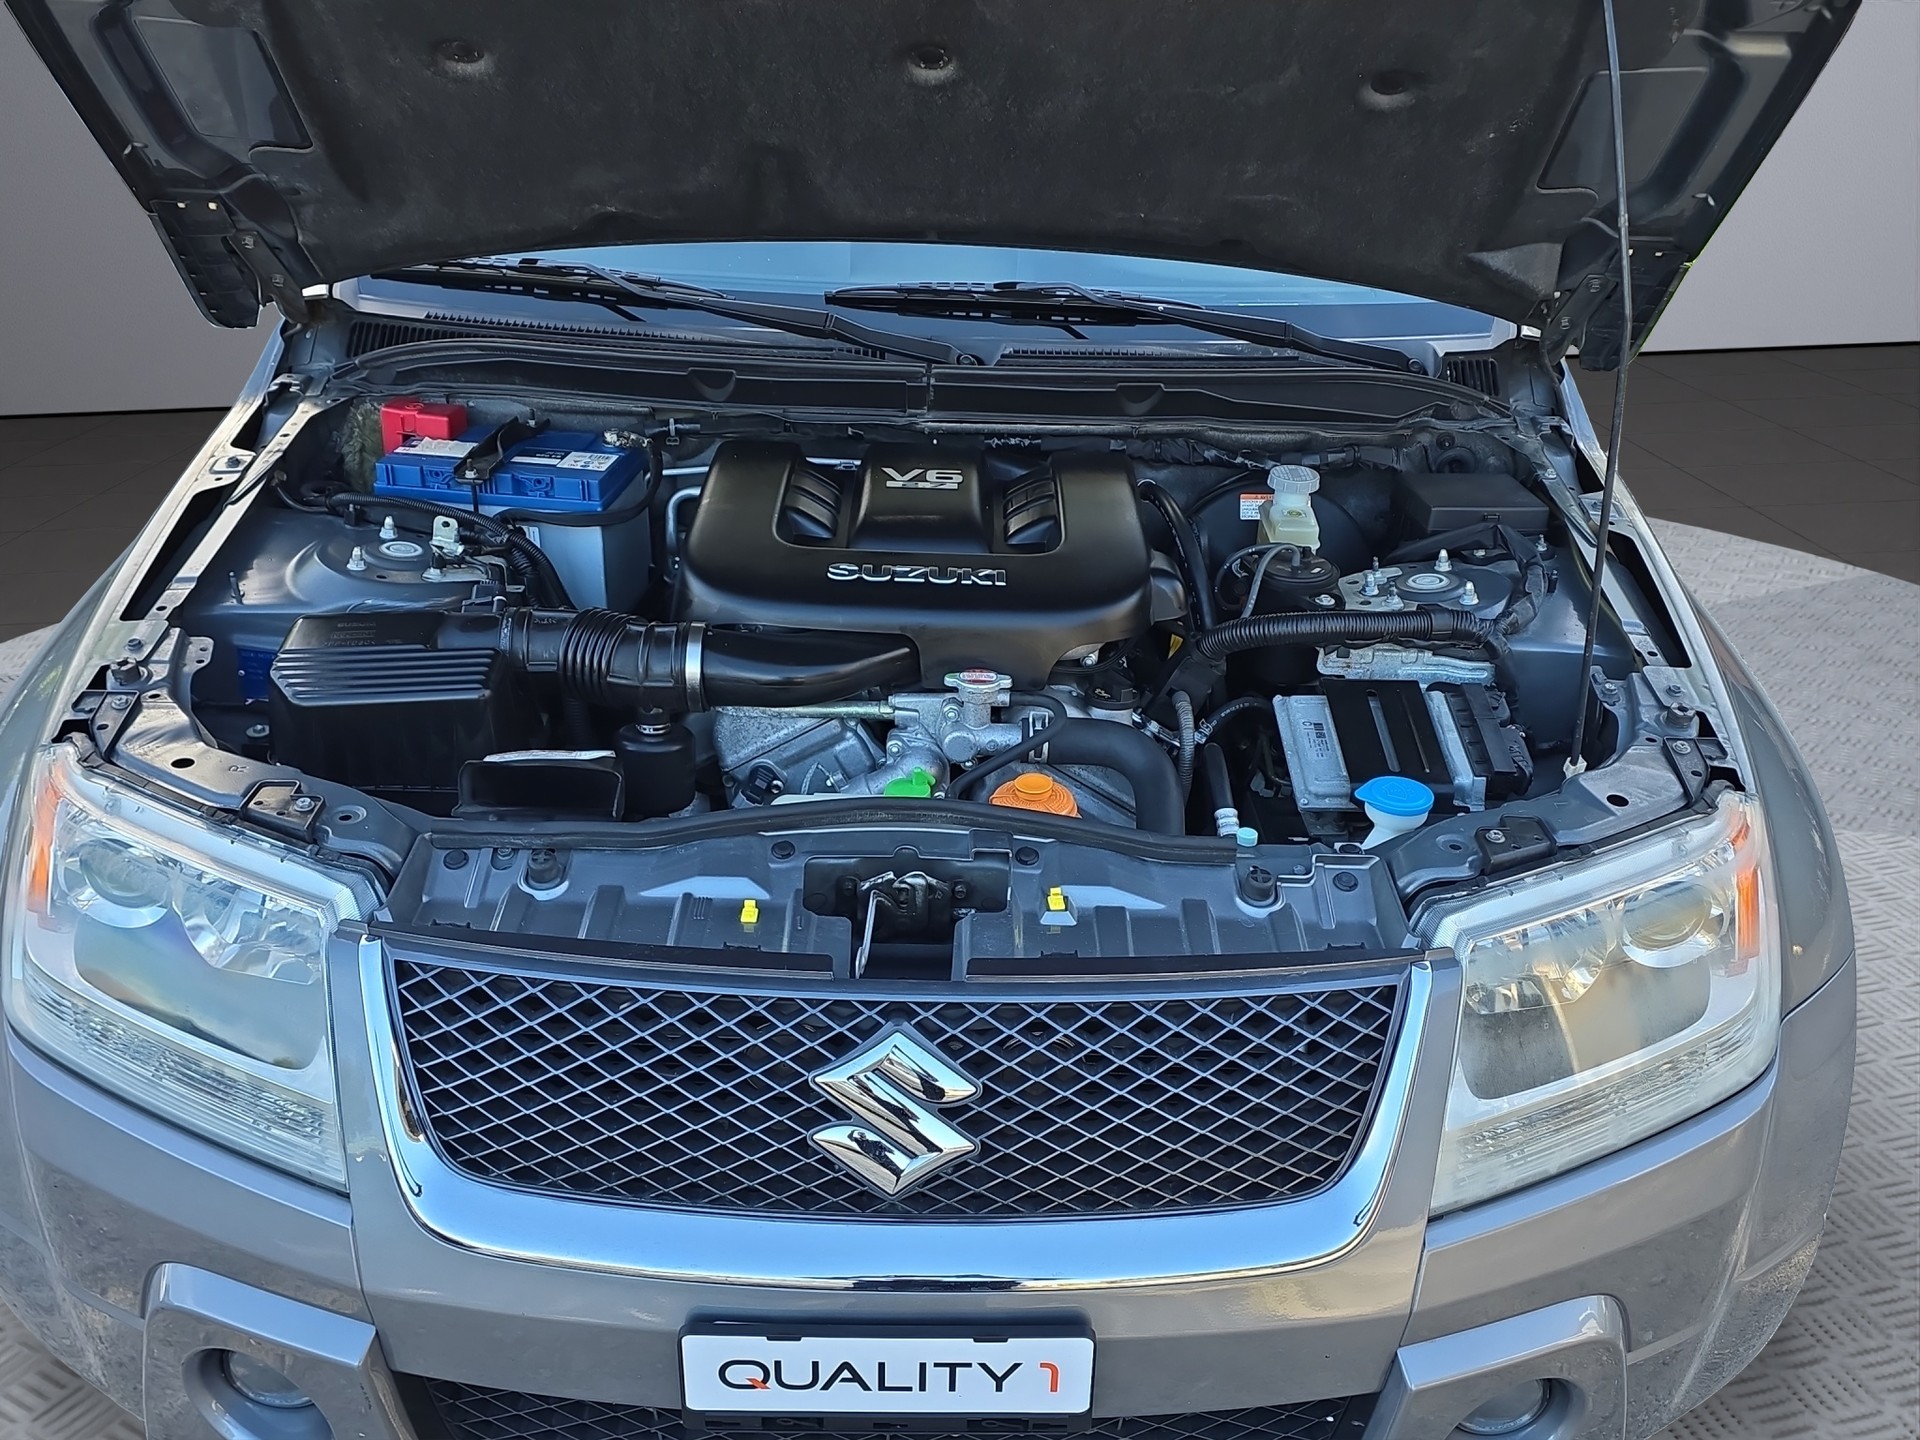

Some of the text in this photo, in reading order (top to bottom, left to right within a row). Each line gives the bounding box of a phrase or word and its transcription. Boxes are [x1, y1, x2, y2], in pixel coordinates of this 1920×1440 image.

[881, 467, 963, 483] V6
[828, 563, 1007, 587] SUZUKI
[718, 1359, 1059, 1393] QUALITY 1
